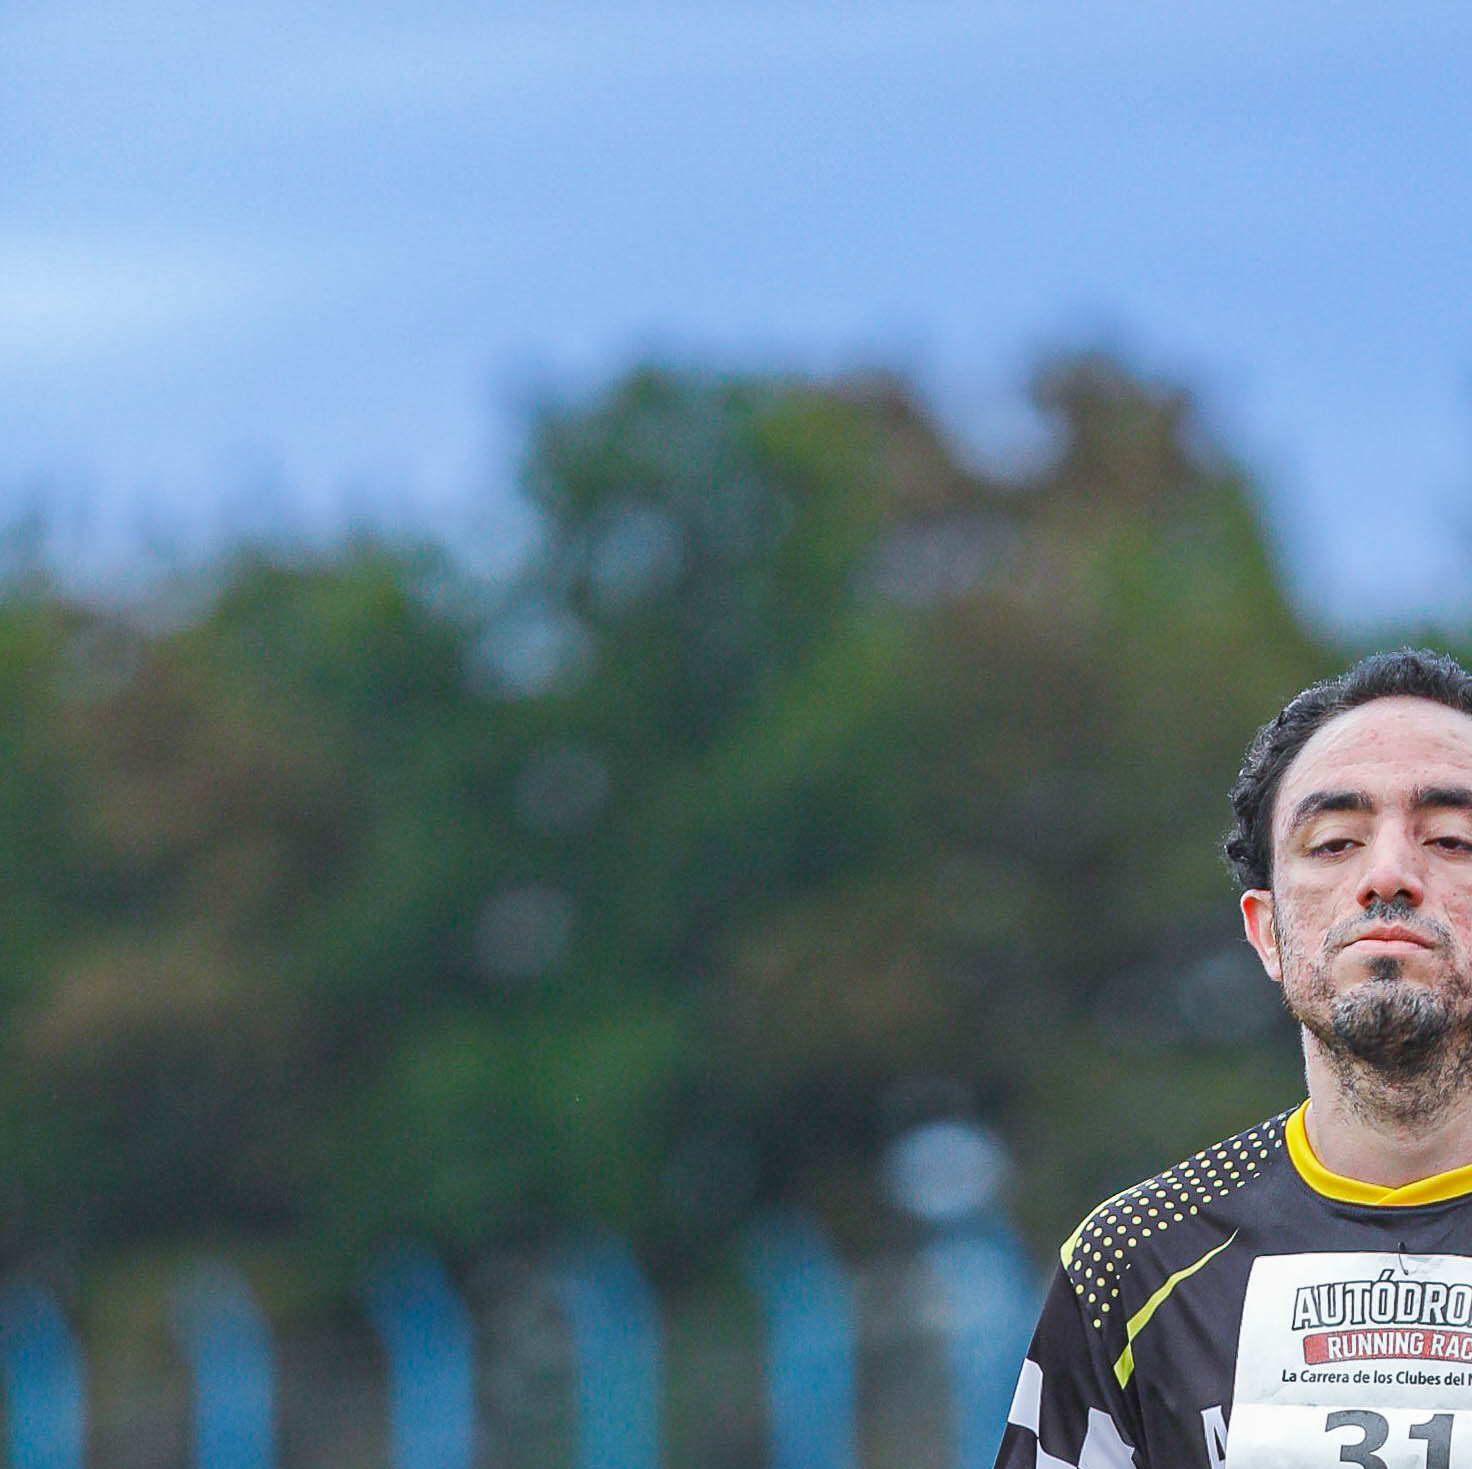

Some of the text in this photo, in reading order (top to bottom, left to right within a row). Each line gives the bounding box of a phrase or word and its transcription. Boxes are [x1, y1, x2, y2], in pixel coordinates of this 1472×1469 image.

[1327, 1332, 1424, 1360] RUNNING
[1281, 1369, 1297, 1383] La
[1300, 1370, 1349, 1384] Carrera
[1353, 1370, 1370, 1384] de
[1373, 1371, 1393, 1384] los
[1396, 1371, 1441, 1386] Clubes
[1444, 1371, 1465, 1386] del
